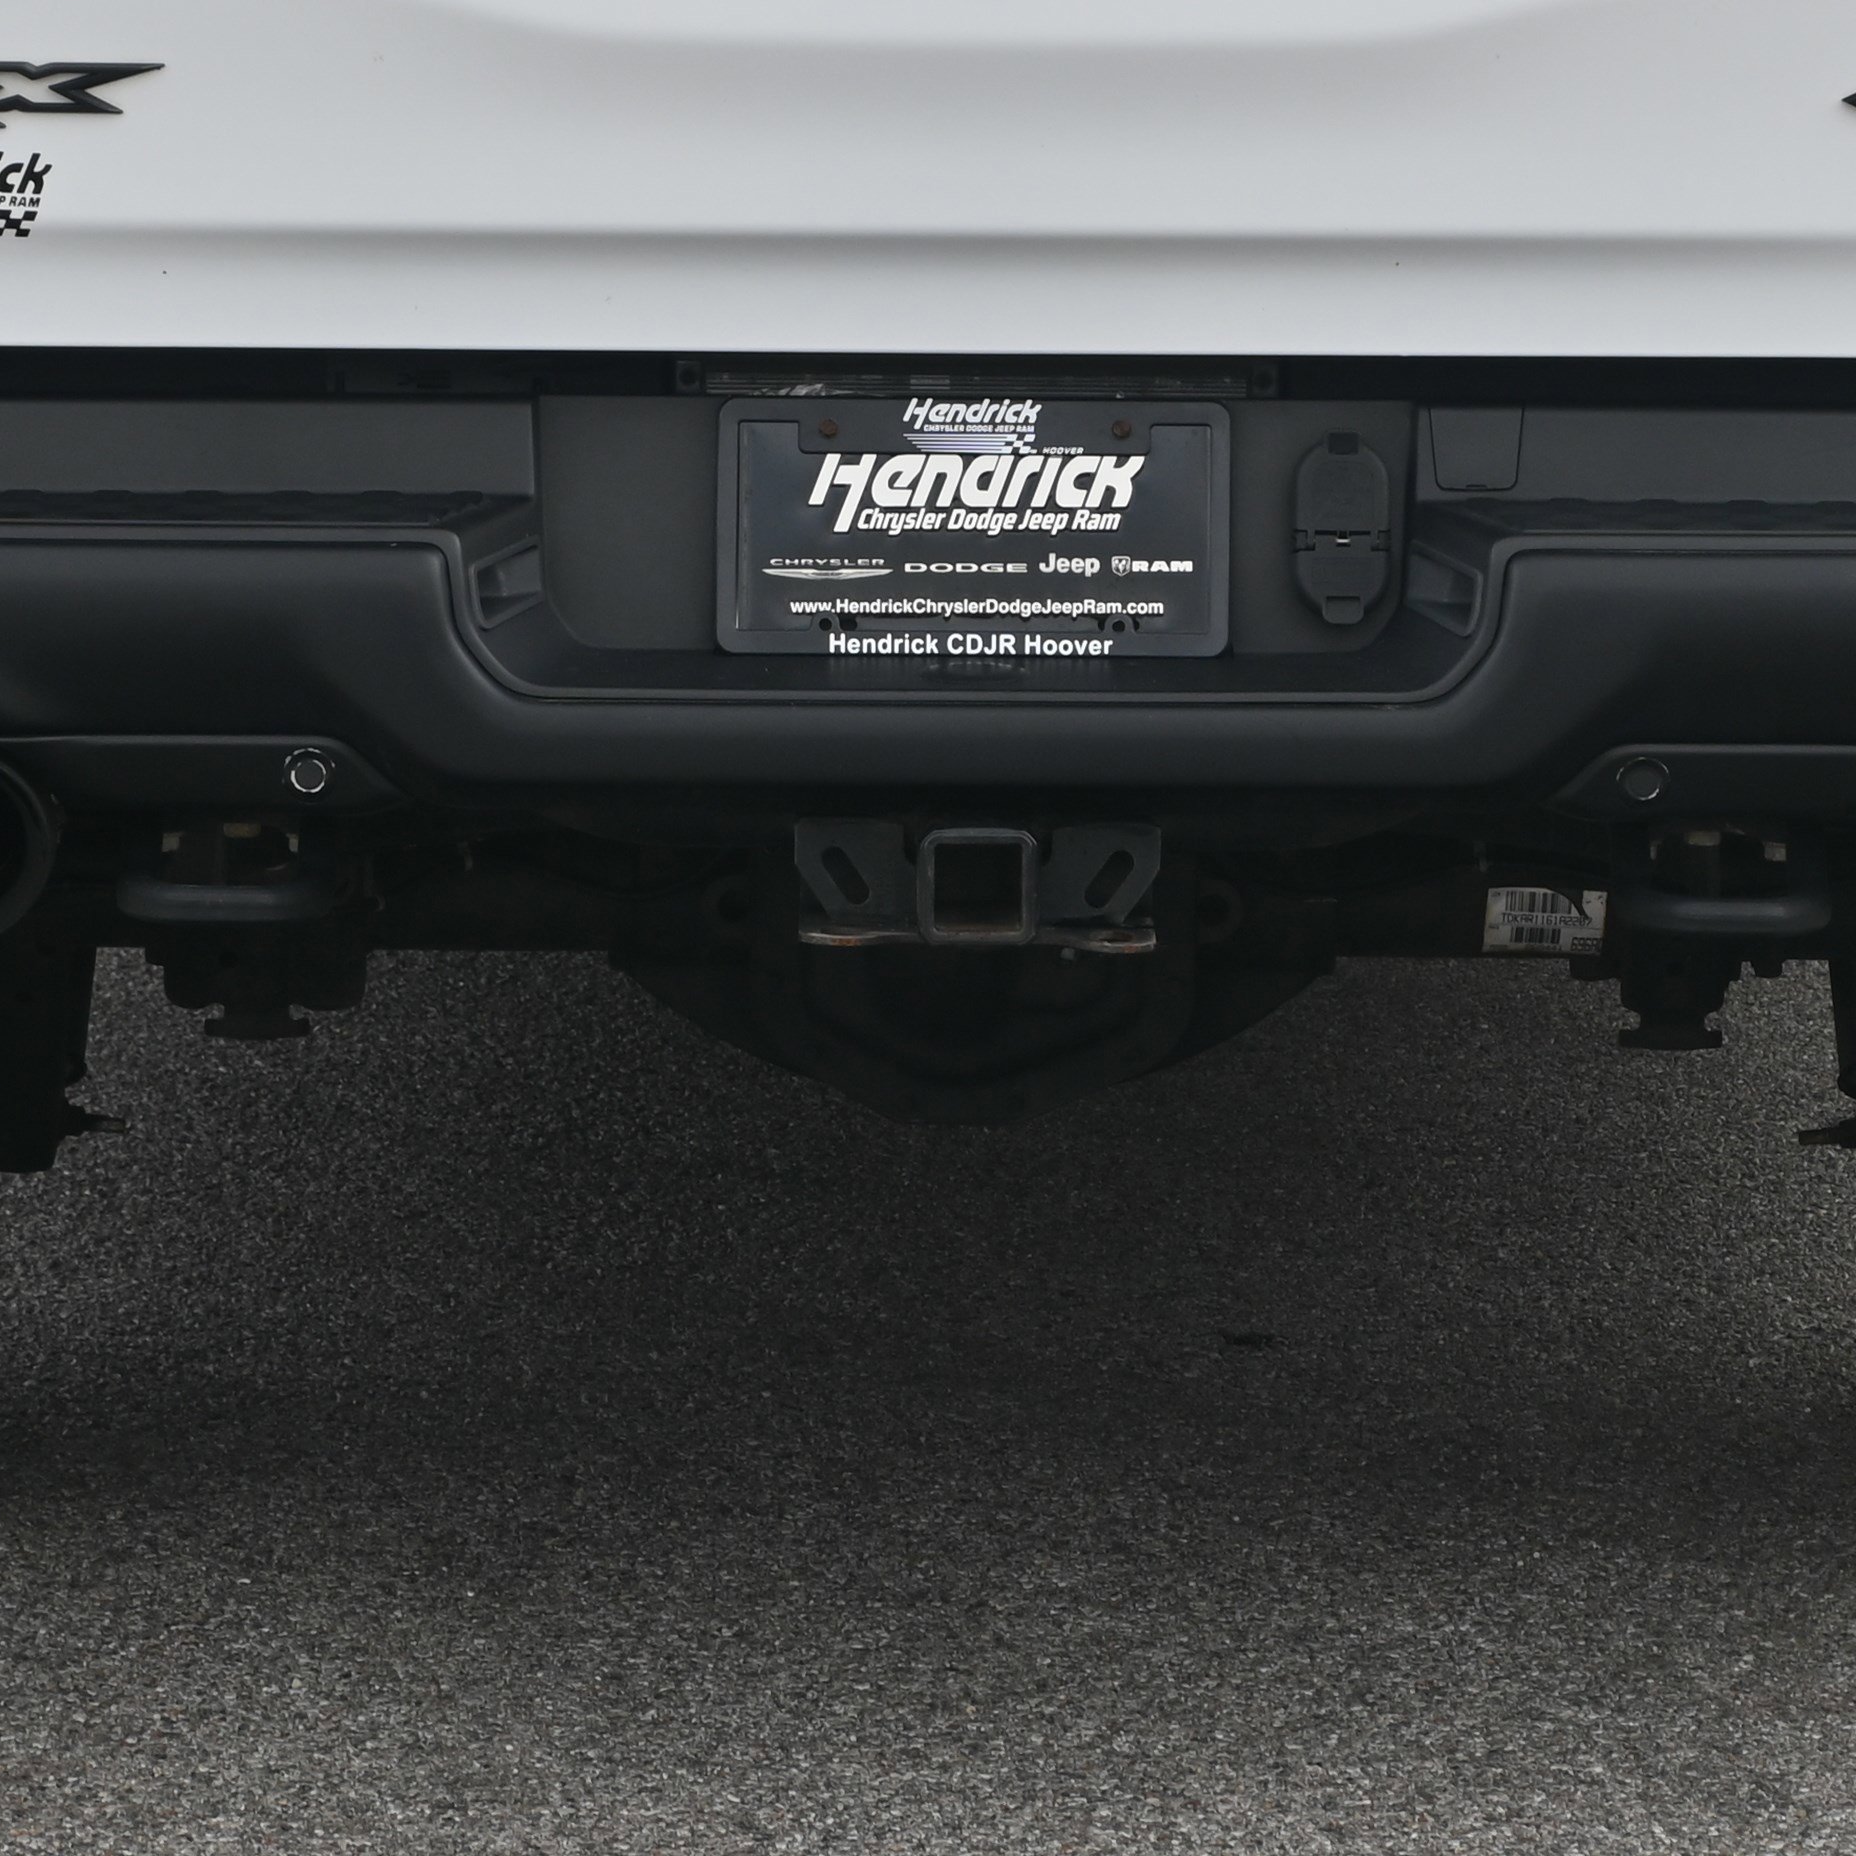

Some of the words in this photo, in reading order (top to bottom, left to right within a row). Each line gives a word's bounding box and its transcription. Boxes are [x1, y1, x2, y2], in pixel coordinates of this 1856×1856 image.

[9, 196, 41, 208] RAM
[902, 397, 1042, 430] Hendrick
[1042, 446, 1084, 455] HOOVER
[857, 508, 947, 536] Chrysler
[947, 508, 1016, 536] Dodge
[1017, 509, 1070, 536] Jeep
[1071, 510, 1121, 531] Ram
[769, 558, 885, 566] CHRYSLER
[904, 562, 1028, 573] DODGE
[1039, 553, 1101, 577] Jeep
[1131, 560, 1193, 573] RAM
[790, 598, 1164, 618] www.HendrickChryslerDodgeJeepRam.com
[829, 632, 939, 654] Hendrick
[947, 633, 1016, 655] CDJR
[1024, 633, 1114, 655] Hoover
